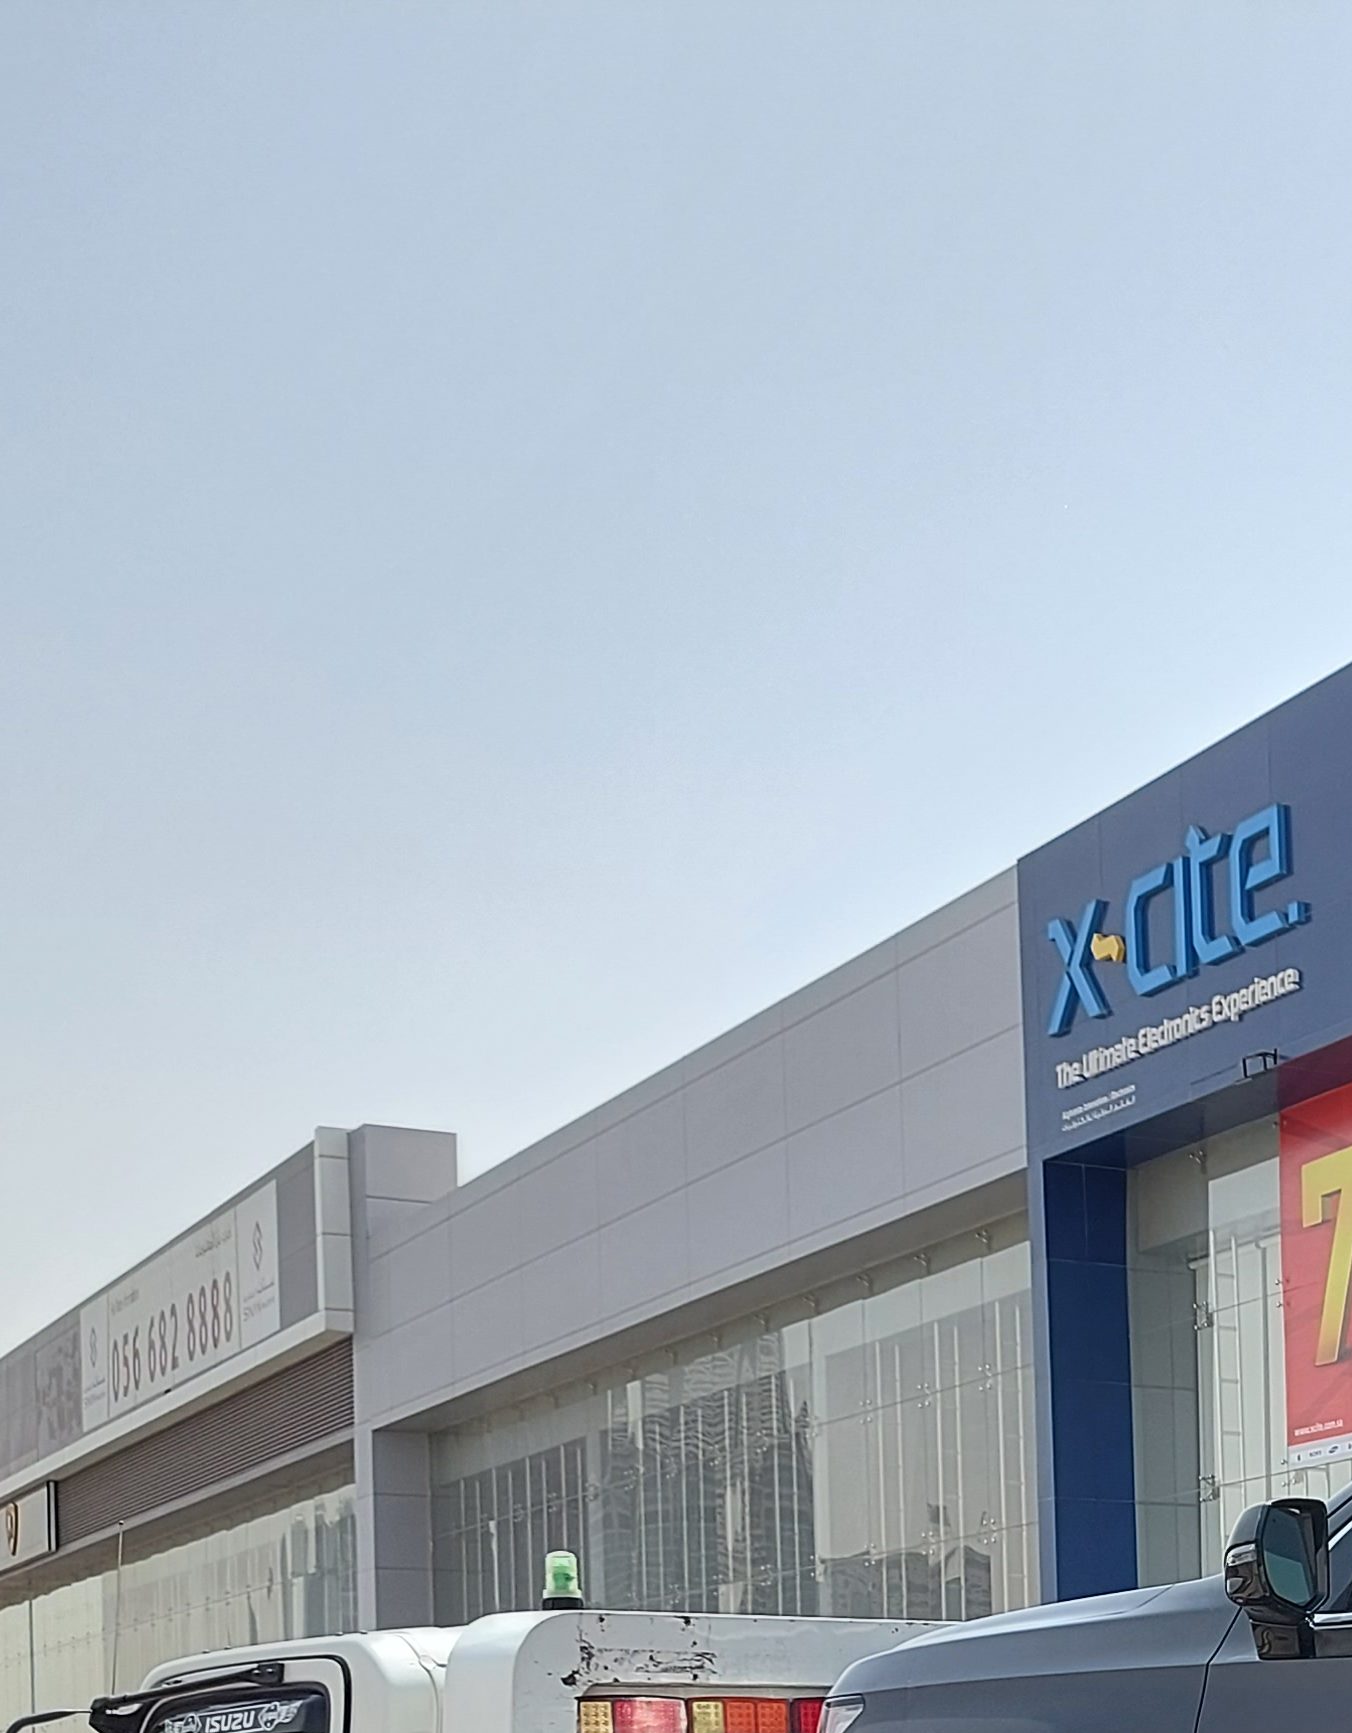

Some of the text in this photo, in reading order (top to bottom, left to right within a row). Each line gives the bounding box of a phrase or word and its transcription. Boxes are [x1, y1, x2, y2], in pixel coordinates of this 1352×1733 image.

[1056, 968, 1301, 1089] The Ultimate Electronics Experience
[112, 1325, 141, 1403] 056
[148, 1303, 179, 1383] 682
[186, 1270, 233, 1362] 8888
[205, 1711, 255, 1733] ISUZU
